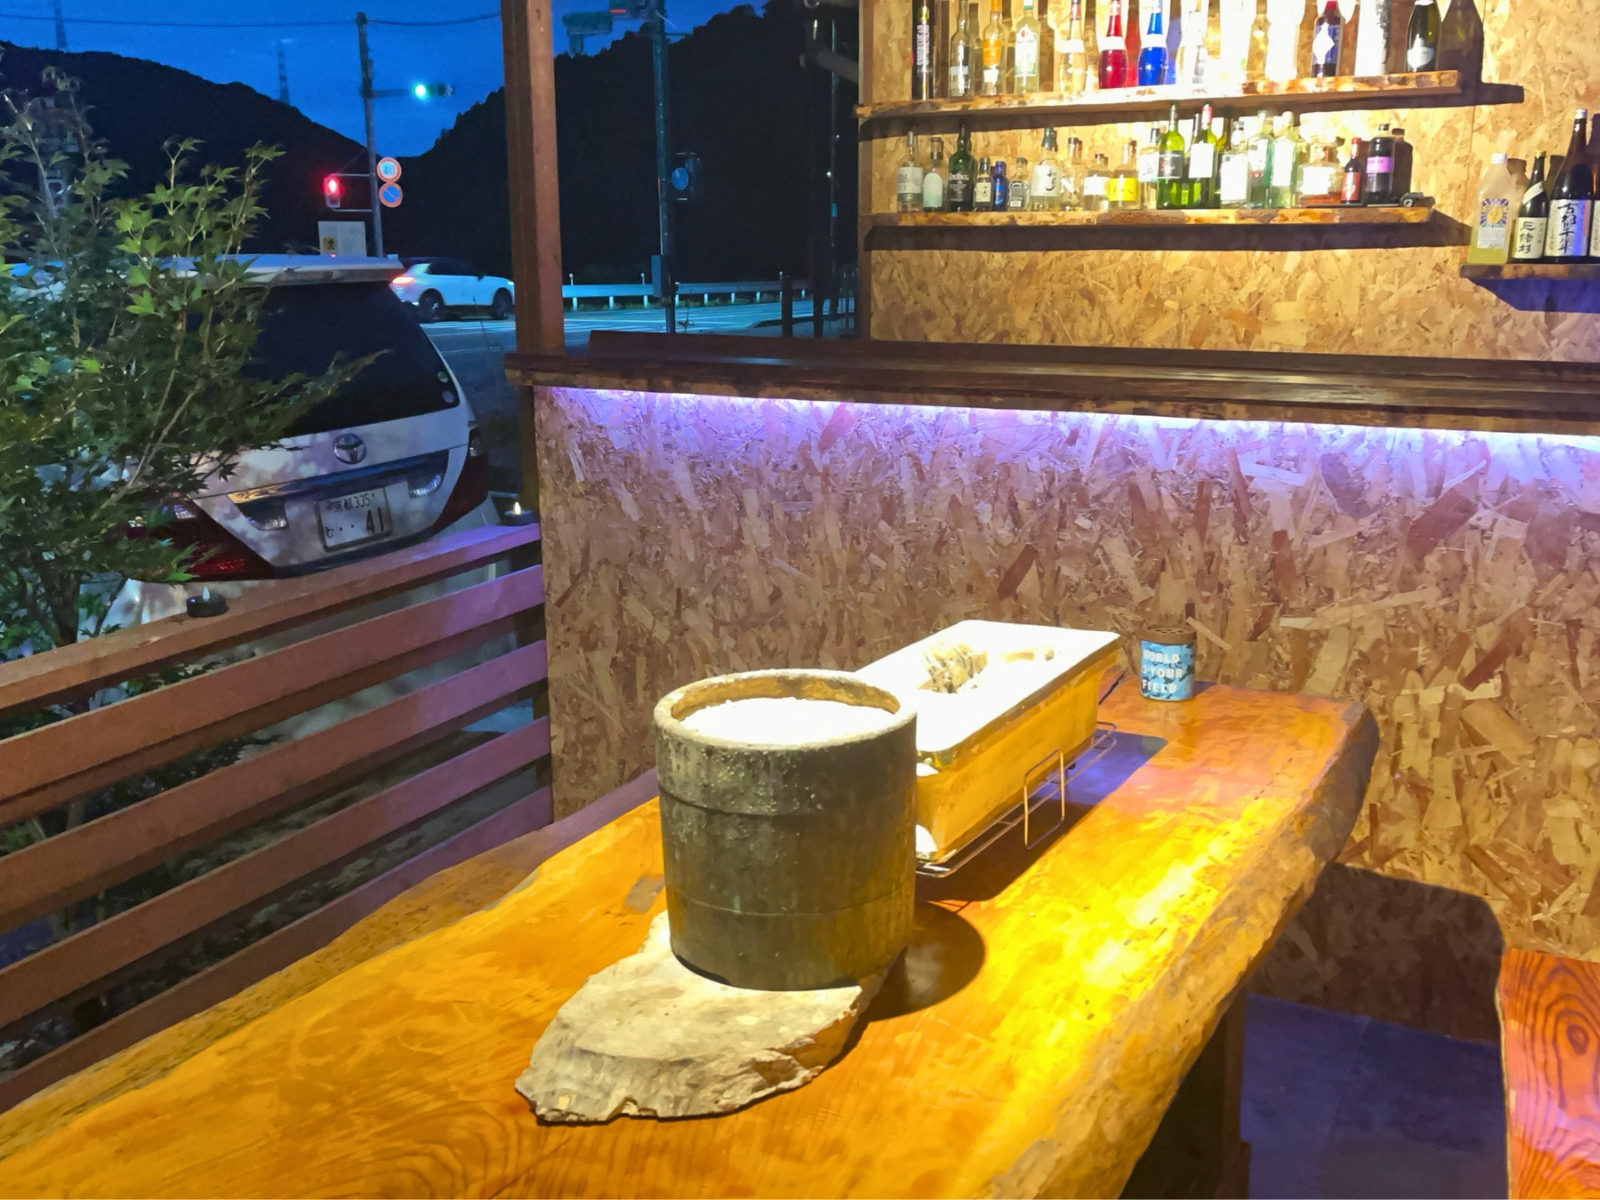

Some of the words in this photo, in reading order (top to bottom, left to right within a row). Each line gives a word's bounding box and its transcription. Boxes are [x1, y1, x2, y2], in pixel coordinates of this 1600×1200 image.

[1142, 649, 1180, 663] WORLD
[1150, 667, 1183, 679] YOUR
[1142, 679, 1177, 693] FIELD
